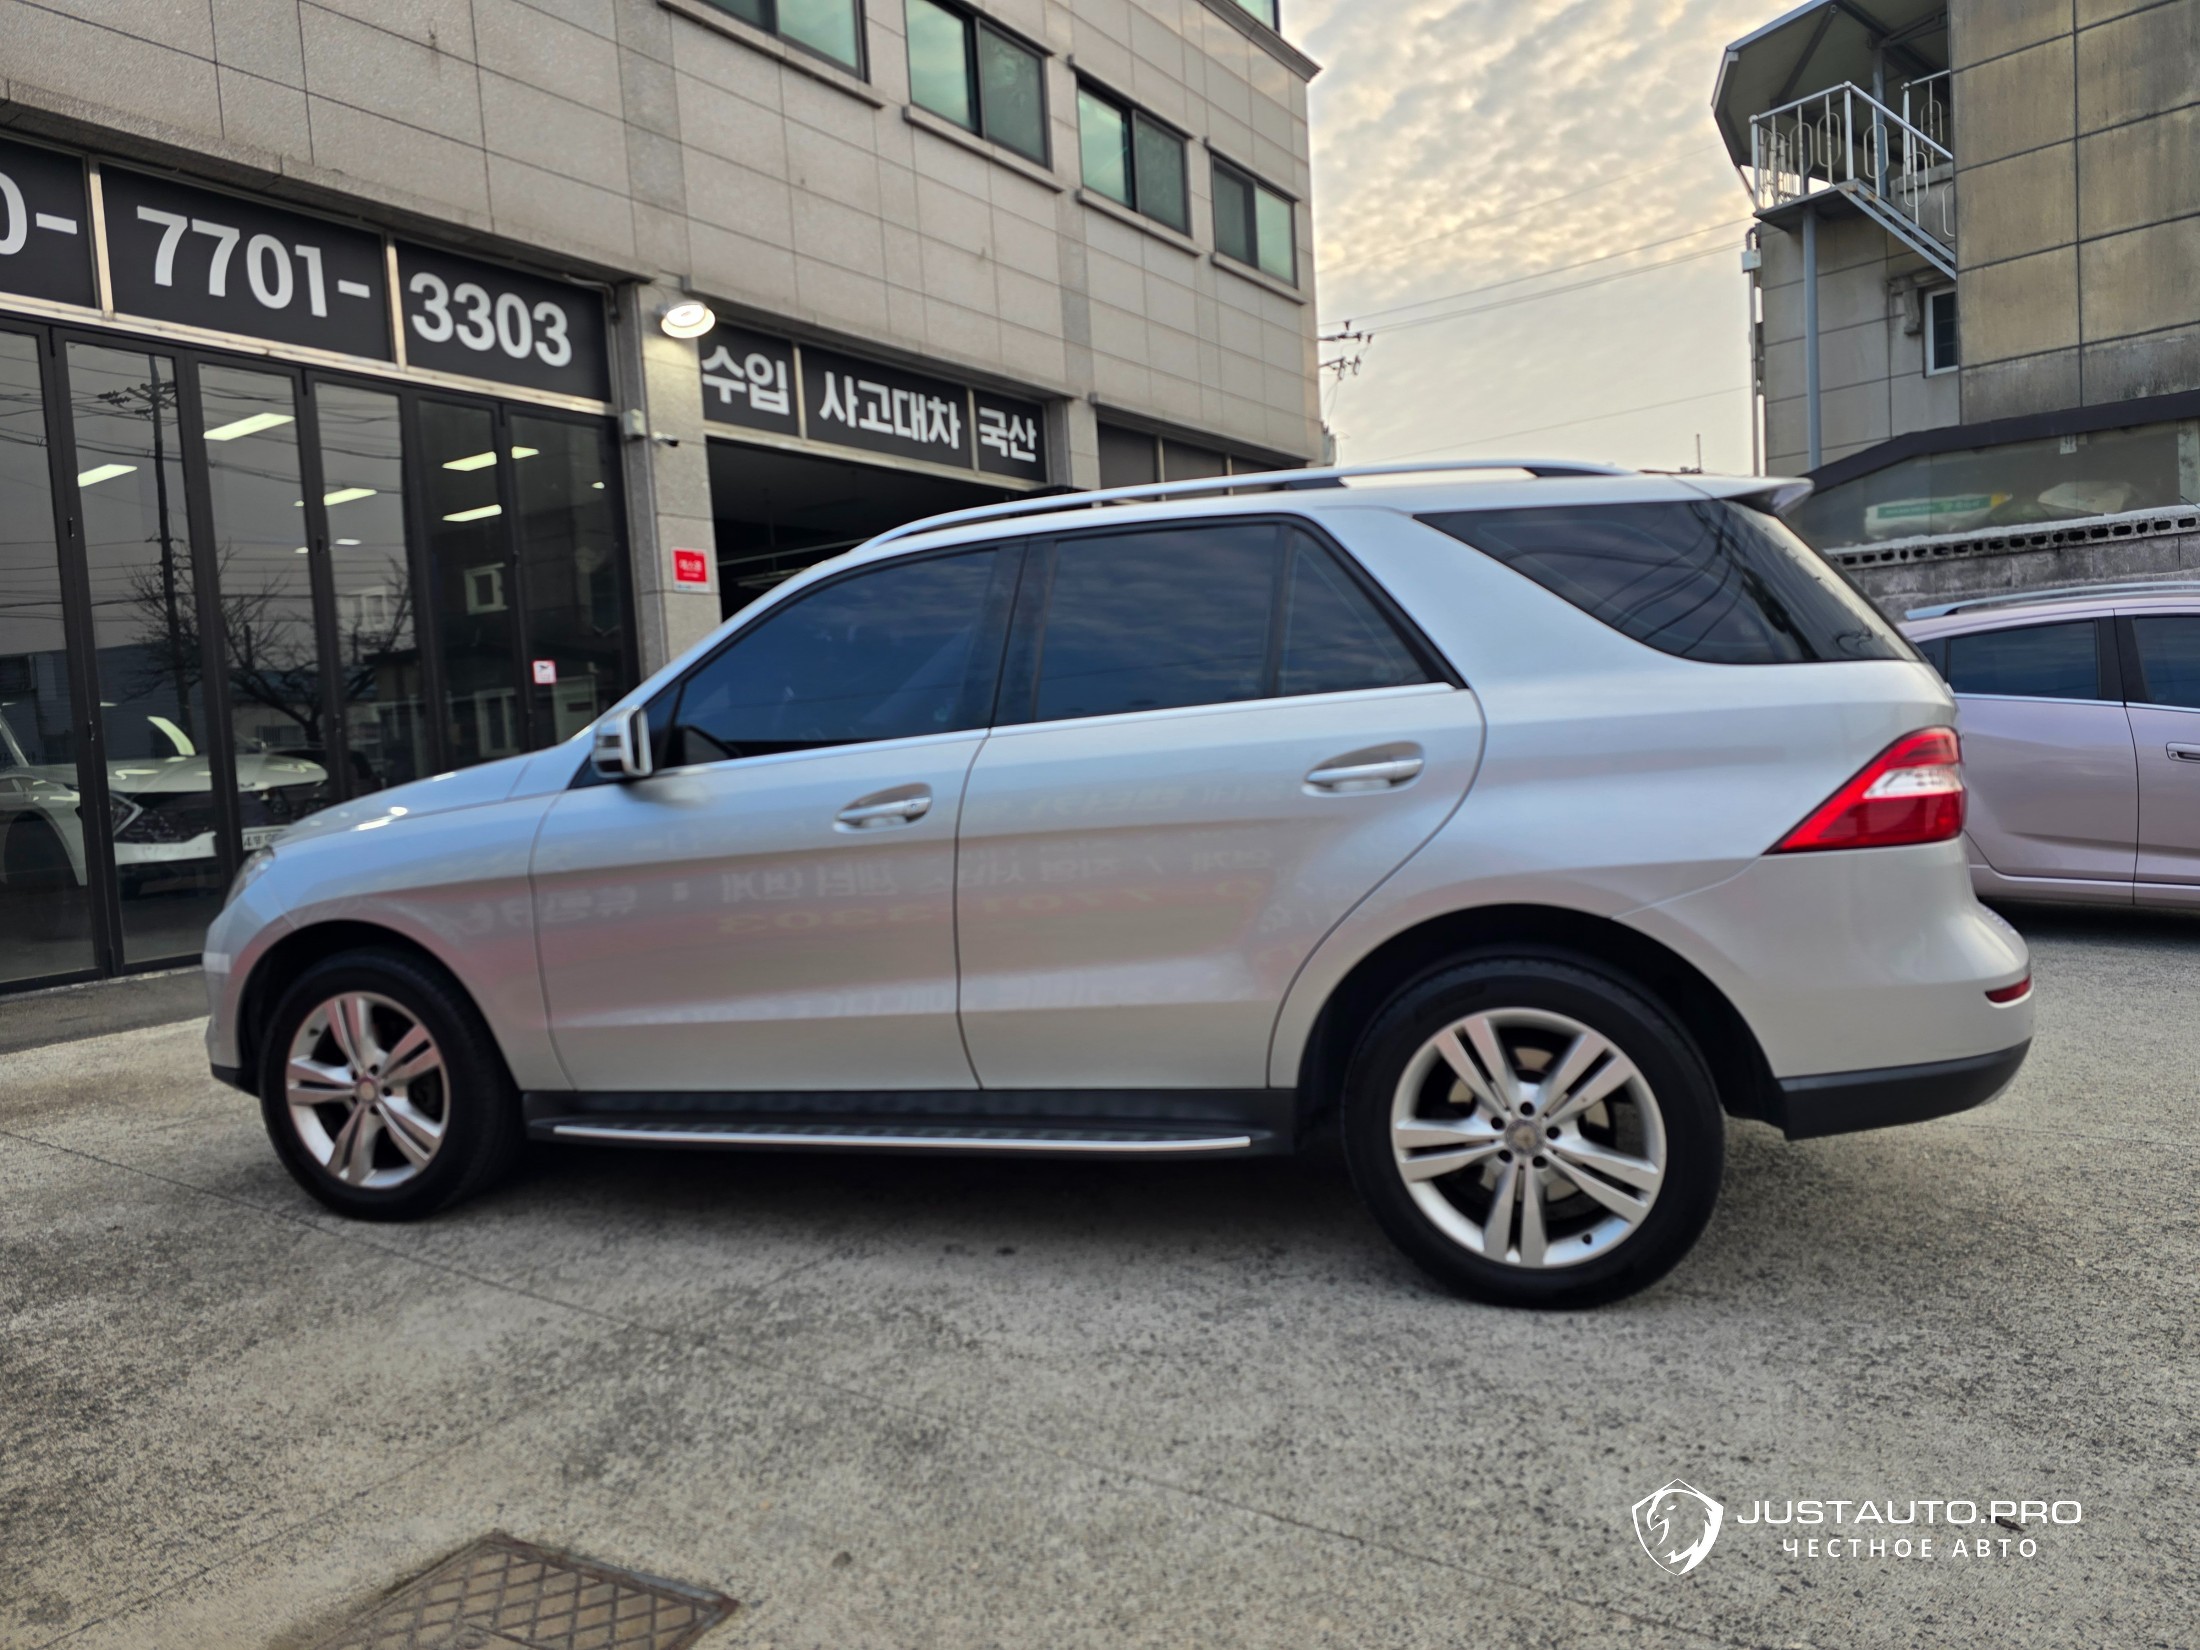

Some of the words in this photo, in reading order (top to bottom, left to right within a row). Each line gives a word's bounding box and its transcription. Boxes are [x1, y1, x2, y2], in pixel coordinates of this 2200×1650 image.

[136, 204, 371, 318] 7701-
[409, 272, 573, 367] 3303
[701, 345, 790, 416] 수입
[819, 370, 961, 450] 사고대차
[978, 406, 1037, 462] 국산
